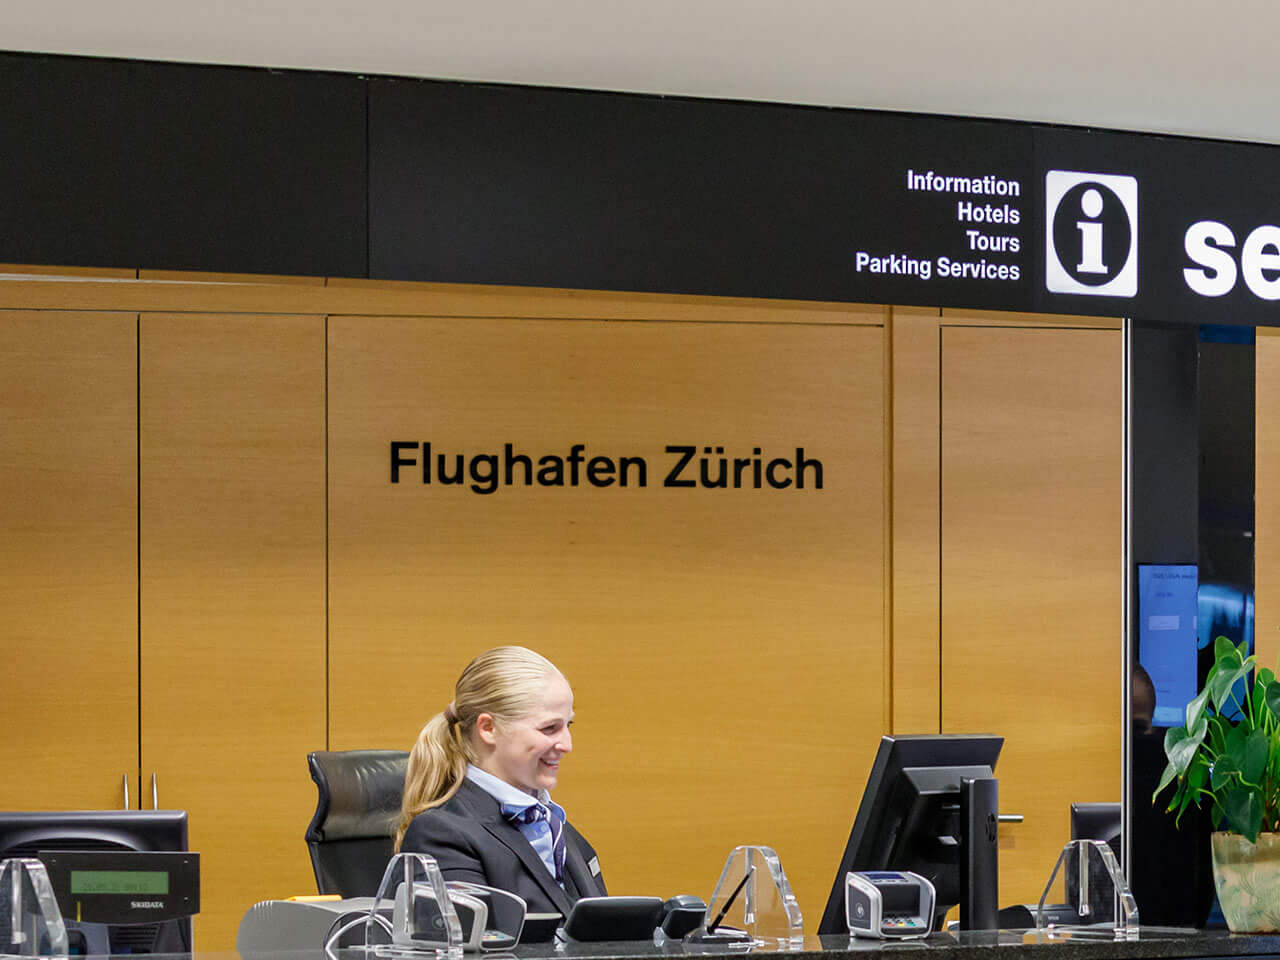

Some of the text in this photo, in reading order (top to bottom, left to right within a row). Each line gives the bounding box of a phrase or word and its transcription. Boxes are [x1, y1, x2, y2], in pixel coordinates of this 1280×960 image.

[907, 168, 1021, 197] Information
[957, 201, 1021, 225] Hotels
[966, 230, 1021, 254] Tours
[855, 251, 1021, 282] Parking Services
[390, 441, 825, 495] Flughafen Zürich
